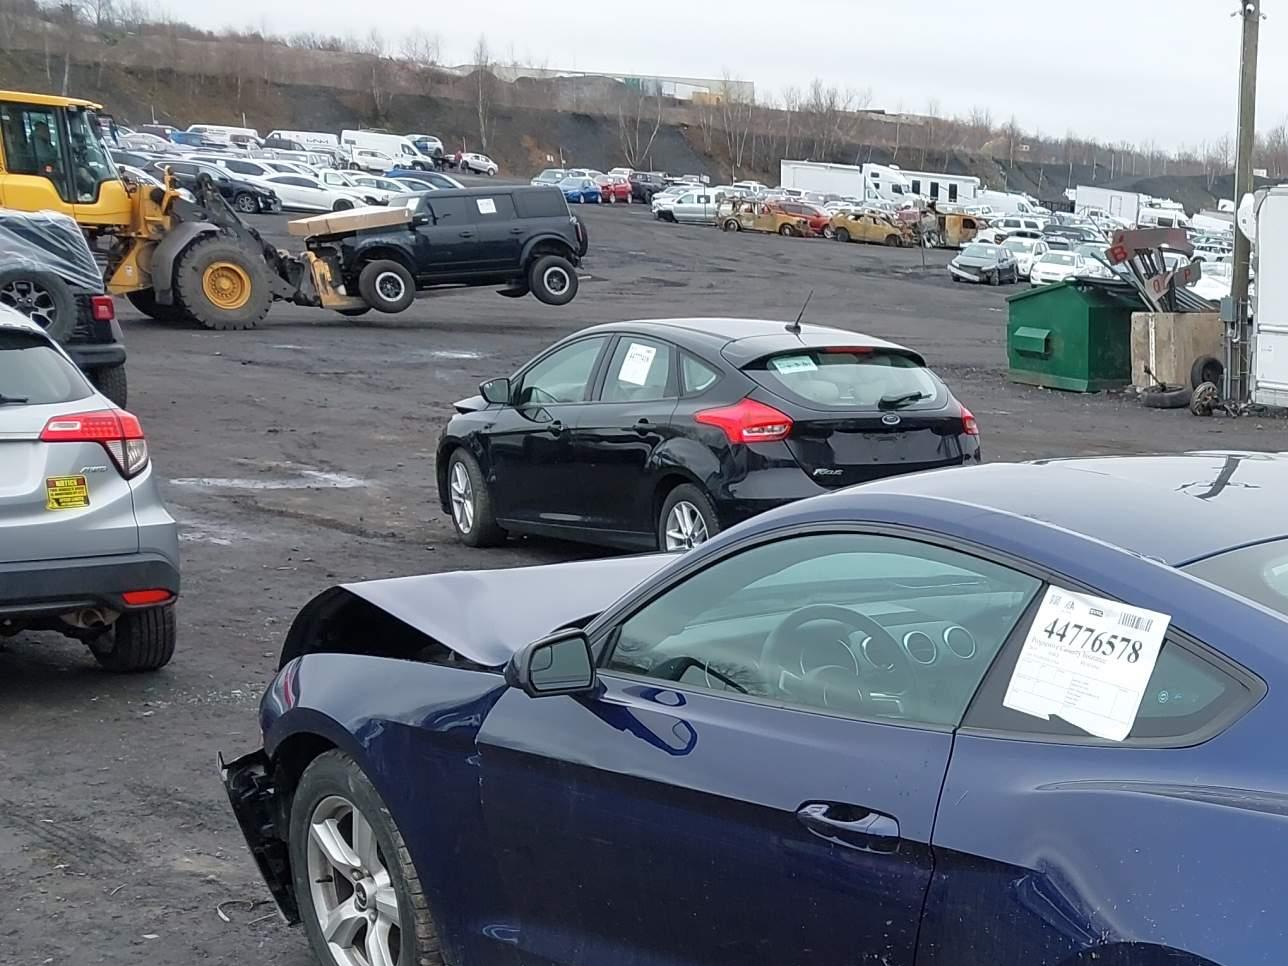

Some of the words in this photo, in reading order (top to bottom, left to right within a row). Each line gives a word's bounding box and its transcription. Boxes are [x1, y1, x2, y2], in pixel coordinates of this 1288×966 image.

[1112, 246, 1127, 262] B
[1184, 268, 1191, 280] P
[1043, 617, 1143, 664] 44776578
